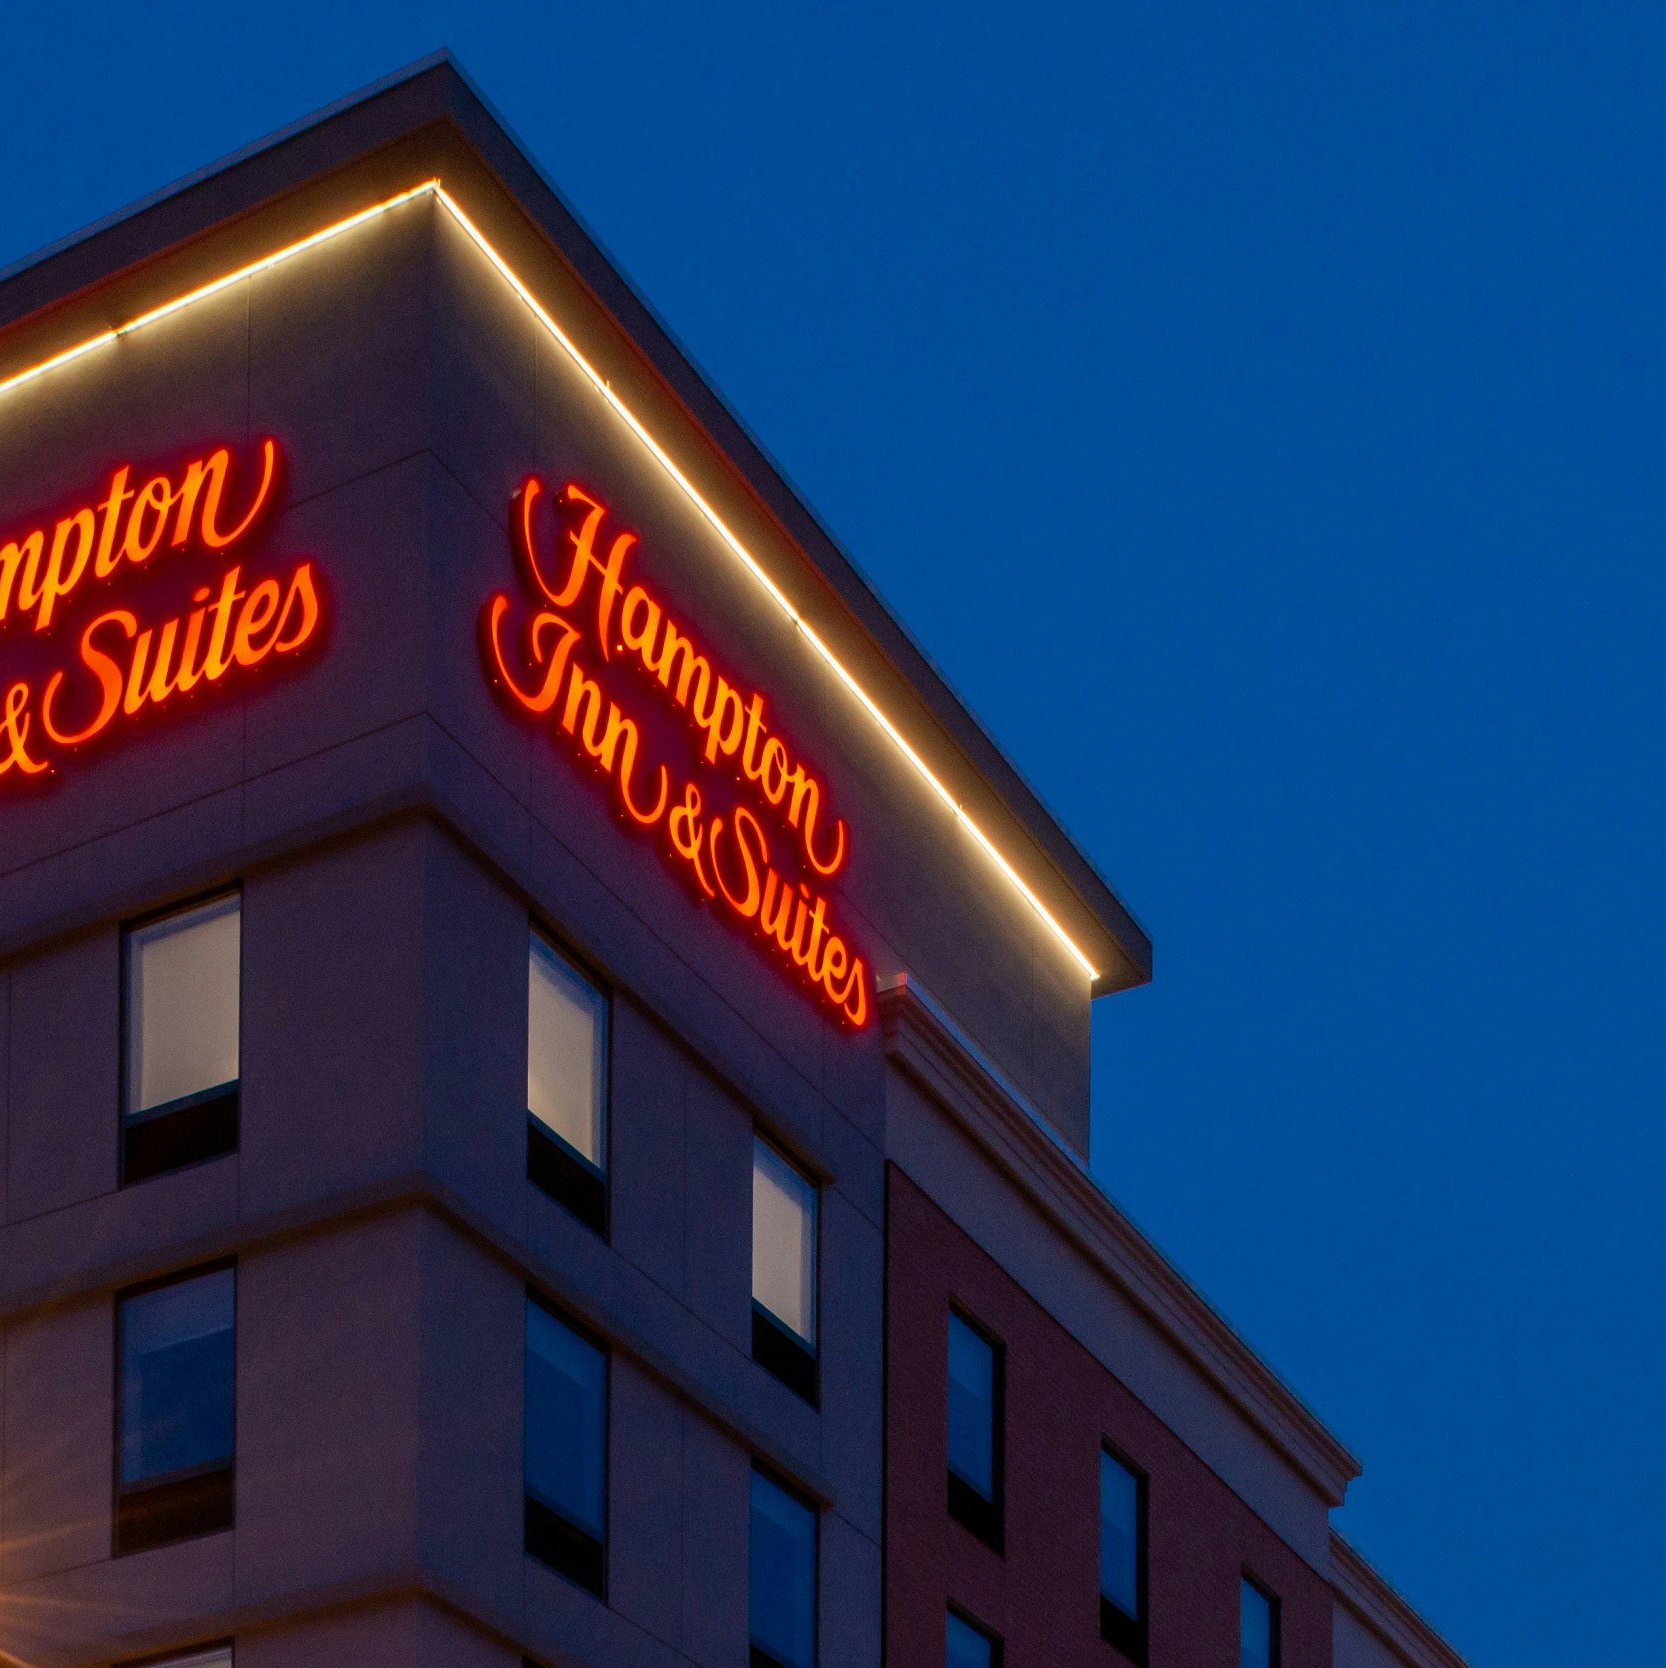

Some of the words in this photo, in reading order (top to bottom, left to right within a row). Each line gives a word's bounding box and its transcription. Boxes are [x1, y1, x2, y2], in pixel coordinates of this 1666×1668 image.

[42, 562, 319, 744] Suites
[491, 594, 668, 824] Inn
[669, 783, 715, 898] &
[709, 807, 867, 1026] Suites
[523, 478, 845, 875] Hampton
